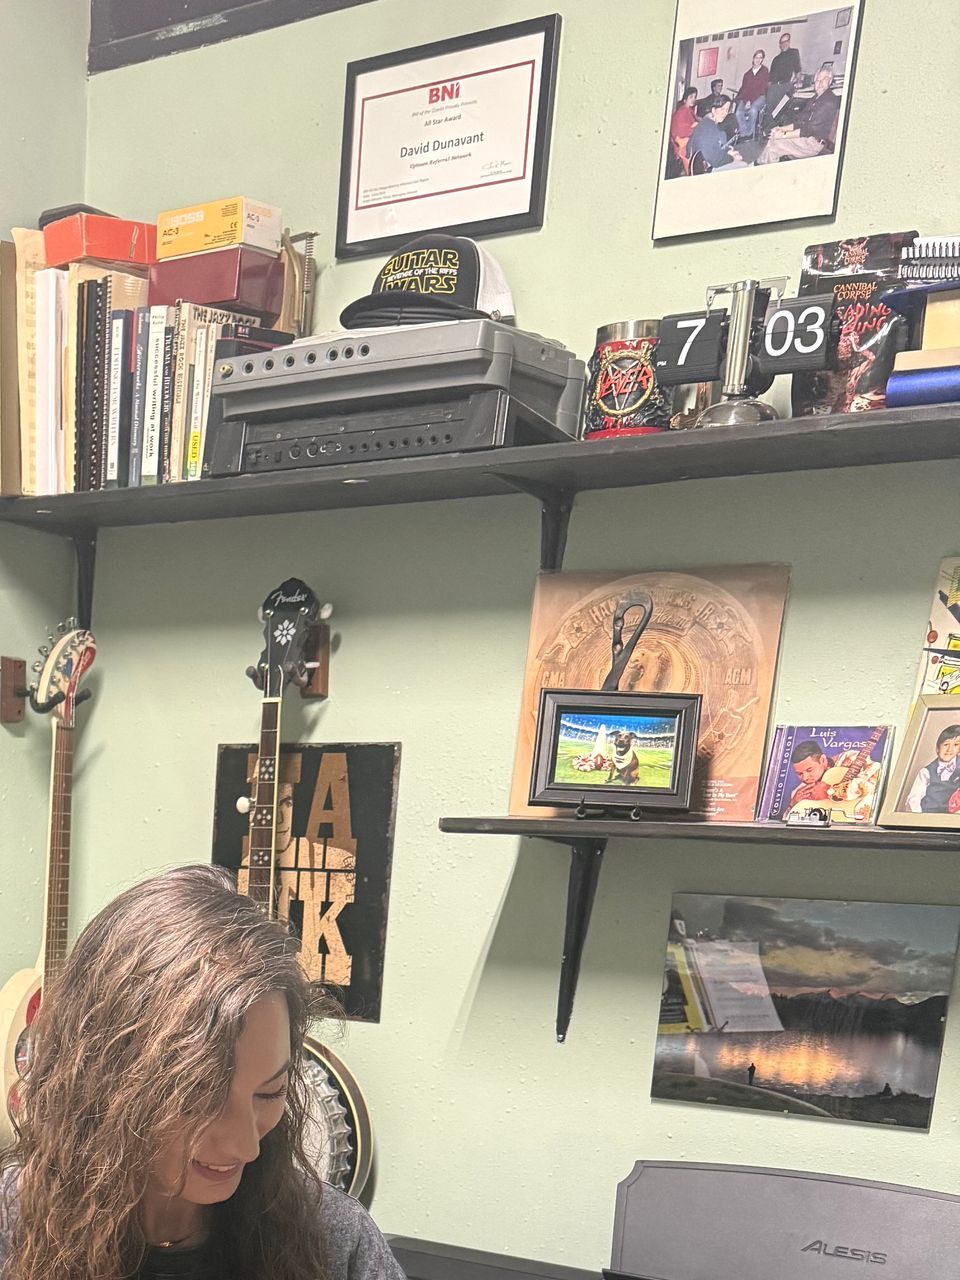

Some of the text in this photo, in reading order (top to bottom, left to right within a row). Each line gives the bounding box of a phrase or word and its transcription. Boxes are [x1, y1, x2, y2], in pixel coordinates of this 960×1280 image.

[432, 118, 443, 126] Star
[444, 114, 462, 123] Award
[400, 131, 484, 158] David Dunavant
[381, 249, 459, 278] GUITAR
[414, 268, 424, 276] OF
[386, 275, 457, 294] WARS
[833, 281, 878, 293] CANNIBAL
[837, 289, 872, 301] CORPSE
[764, 305, 826, 357] 03
[164, 334, 172, 365] TRAUMA
[675, 318, 706, 366] 7
[148, 337, 161, 458] successful writing at work
[191, 435, 199, 459] USED
[270, 588, 309, 607] Fender
[809, 727, 837, 738] Luis
[822, 737, 867, 750] Vargas
[799, 1239, 888, 1266] ALESIS
